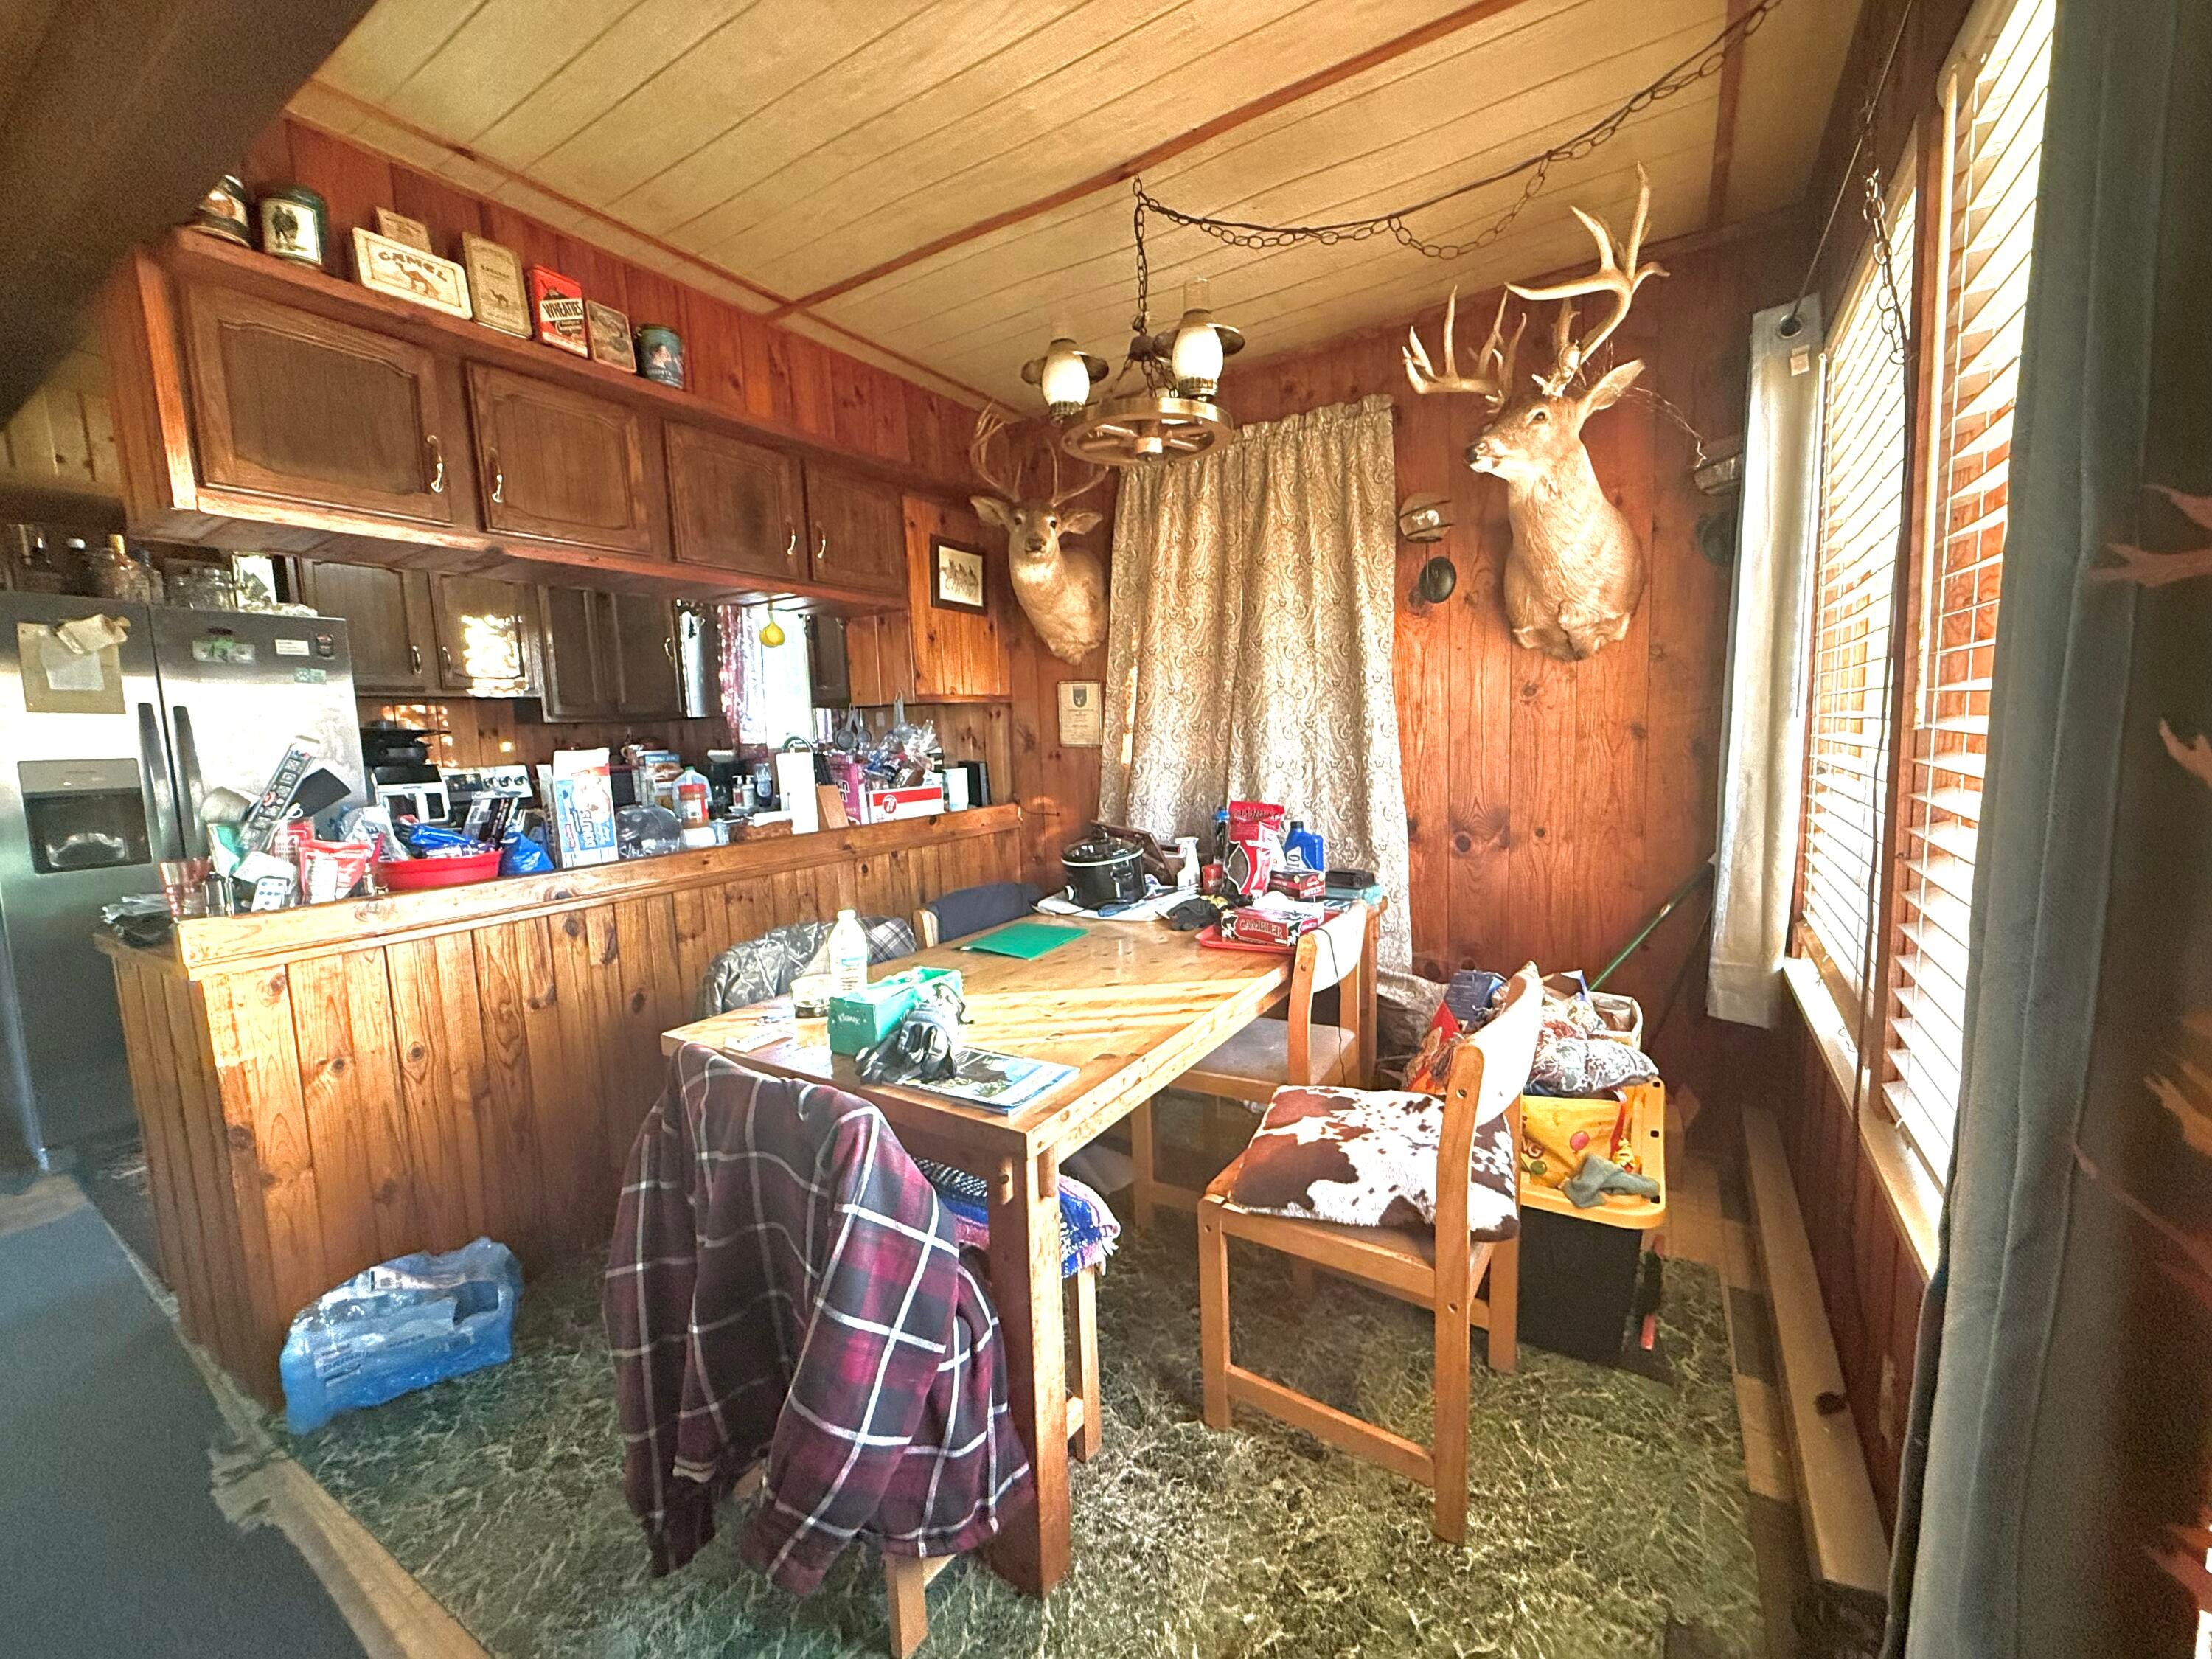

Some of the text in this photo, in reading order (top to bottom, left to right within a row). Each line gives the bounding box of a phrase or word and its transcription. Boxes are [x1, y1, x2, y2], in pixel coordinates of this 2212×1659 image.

[378, 251, 448, 282] CAMEL
[541, 300, 583, 319] WHEATIES
[580, 810, 597, 849] DONUTS
[1239, 919, 1284, 939] GAMBLER
